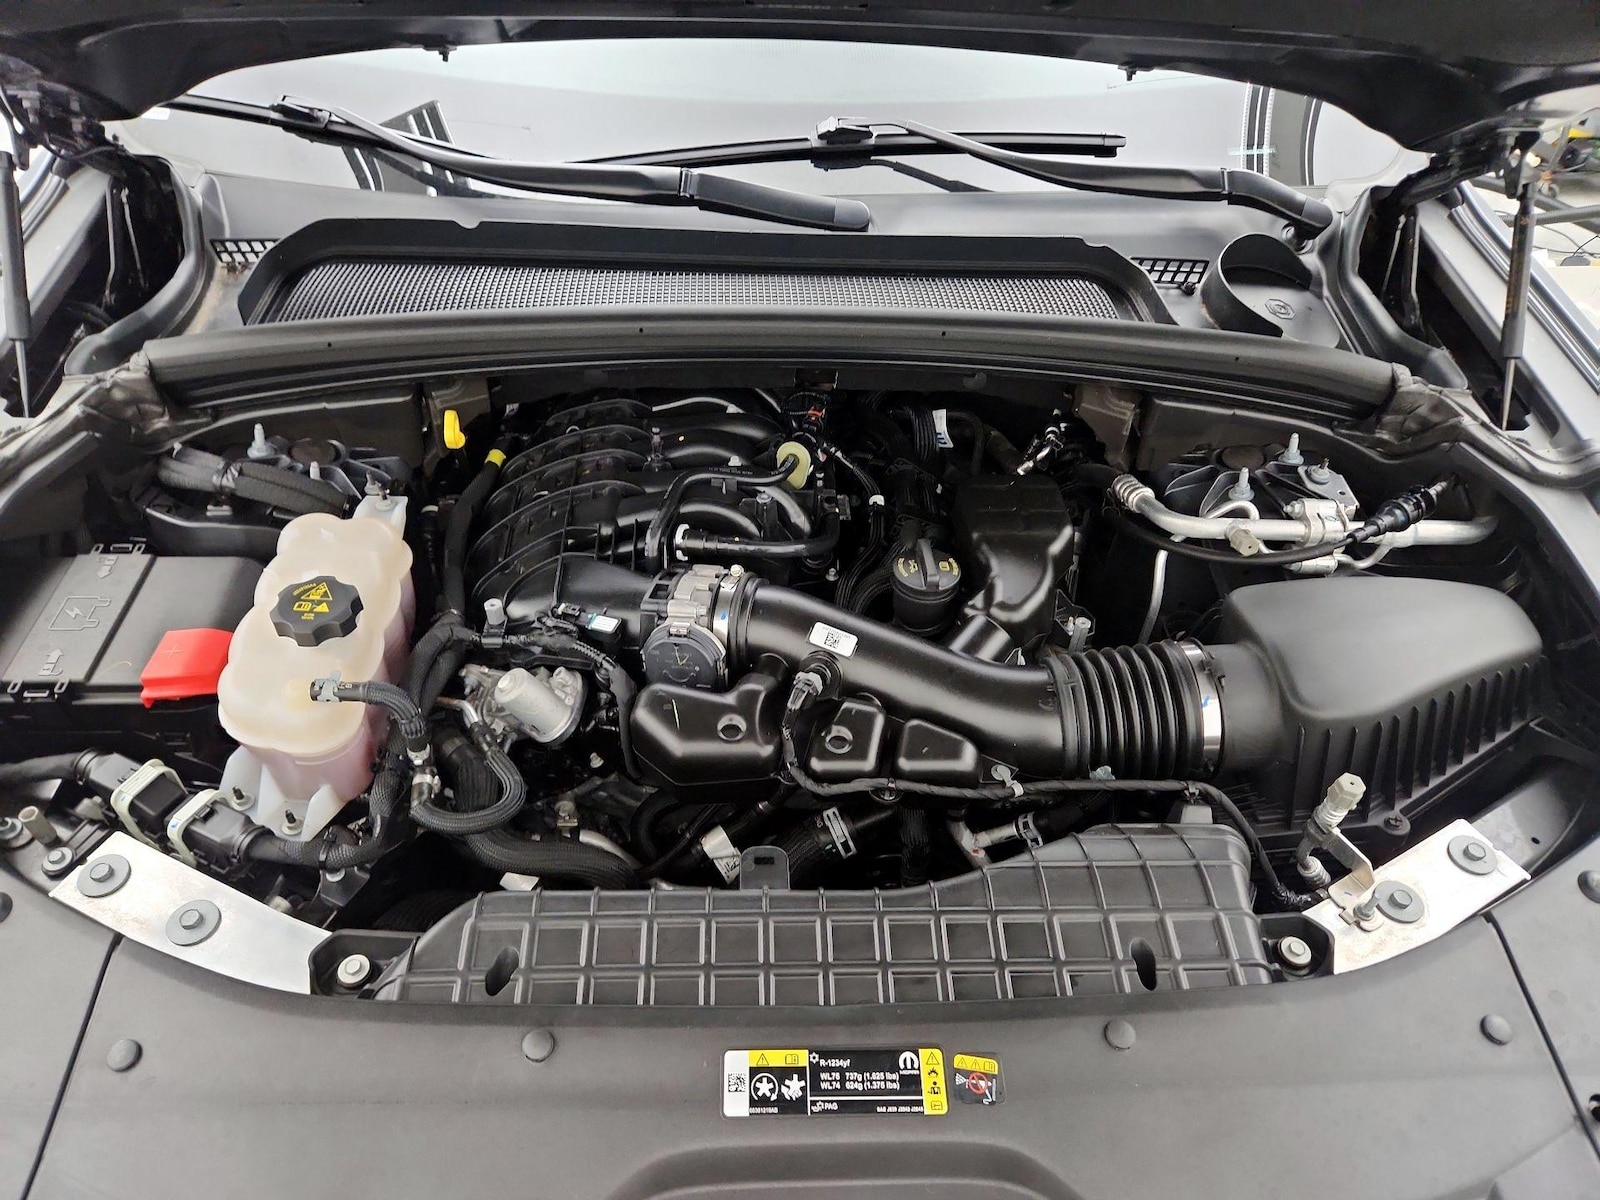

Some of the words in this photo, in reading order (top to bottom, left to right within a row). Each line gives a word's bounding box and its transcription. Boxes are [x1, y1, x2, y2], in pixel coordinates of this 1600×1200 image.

[820, 1059, 851, 1069] R-1234yf
[845, 1072, 863, 1082] 737g
[820, 1081, 841, 1090] WL74
[845, 1081, 863, 1091] 624g
[825, 1103, 838, 1111] PAG
